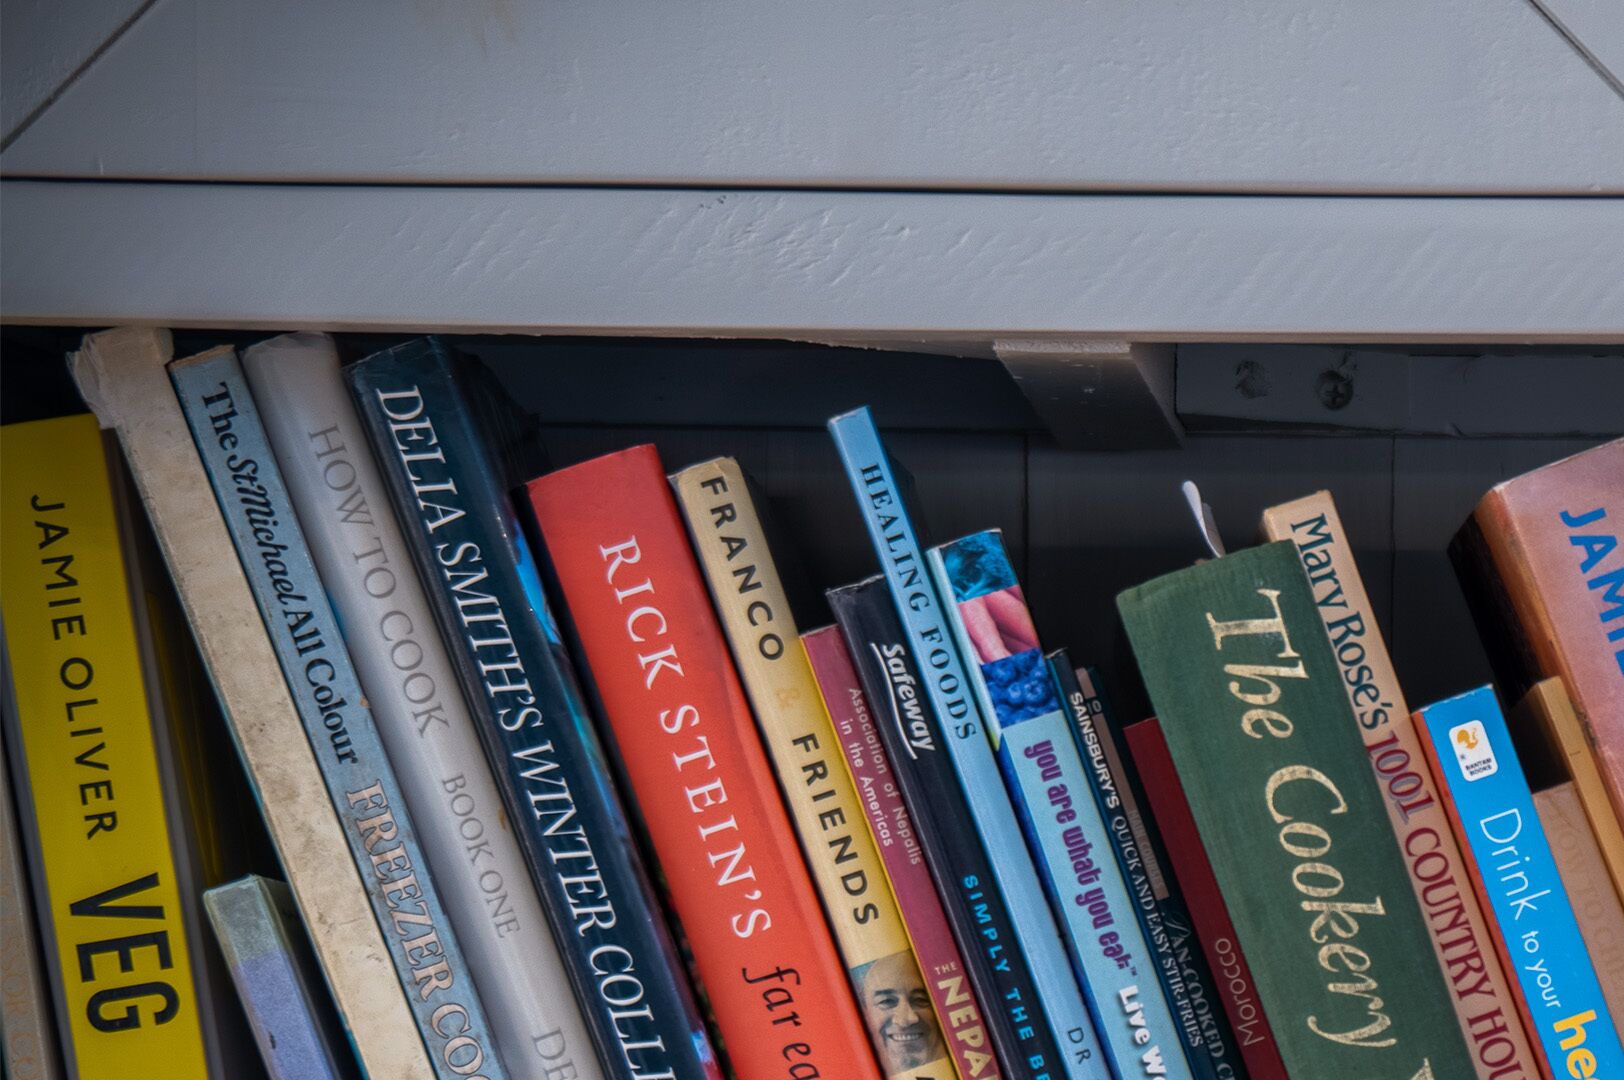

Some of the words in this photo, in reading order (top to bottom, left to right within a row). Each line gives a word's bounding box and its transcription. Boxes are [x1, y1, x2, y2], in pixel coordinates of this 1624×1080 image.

[31, 495, 87, 640] JAMIE
[600, 535, 685, 690] RICK
[860, 464, 930, 615] HEALING
[919, 627, 977, 742] FOODS
[202, 382, 238, 453] The
[283, 607, 319, 657] All
[303, 657, 358, 766] Colour
[346, 779, 456, 1001] FREEZER
[308, 424, 378, 531] HOW
[353, 535, 398, 600] TO
[379, 610, 452, 738] COOK
[441, 772, 487, 864] BOOK
[477, 869, 521, 940] ONE
[375, 384, 466, 535] DELIA
[513, 739, 619, 938] WINTER
[701, 474, 785, 662] FRANCO
[791, 732, 880, 928] FRIENDS
[882, 642, 936, 753] Safeway
[59, 657, 118, 840] OLIVER
[839, 719, 854, 736] in
[846, 741, 864, 768] the
[847, 687, 887, 777] Association
[881, 782, 900, 802] of
[891, 806, 923, 865] Nepalis
[1024, 740, 1061, 785] you
[1291, 514, 1345, 610] Mary
[1366, 731, 1434, 824] 1001
[1405, 826, 1496, 1002] COUNTRY
[859, 775, 894, 848] Americas
[1049, 788, 1076, 826] are
[1061, 827, 1102, 885] what
[1206, 589, 1309, 740] The
[1264, 765, 1397, 1048] Cookery
[1075, 882, 1114, 929] you
[1480, 807, 1551, 921] Drink
[70, 872, 179, 1033] VEG
[934, 961, 957, 976] THE
[964, 873, 1010, 973] SIMPLY
[1005, 987, 1034, 1040] THE
[1111, 815, 1140, 875] QUICK
[1131, 876, 1156, 912] AND
[1147, 914, 1172, 956] EASY
[1162, 957, 1203, 1048] STIR-FRIES
[1522, 930, 1539, 955] to
[1525, 957, 1561, 1009] your
[742, 964, 800, 1028] far
[1067, 1026, 1090, 1065] DR
[1118, 985, 1150, 1048] Live
[1215, 937, 1264, 1048] Morocco
